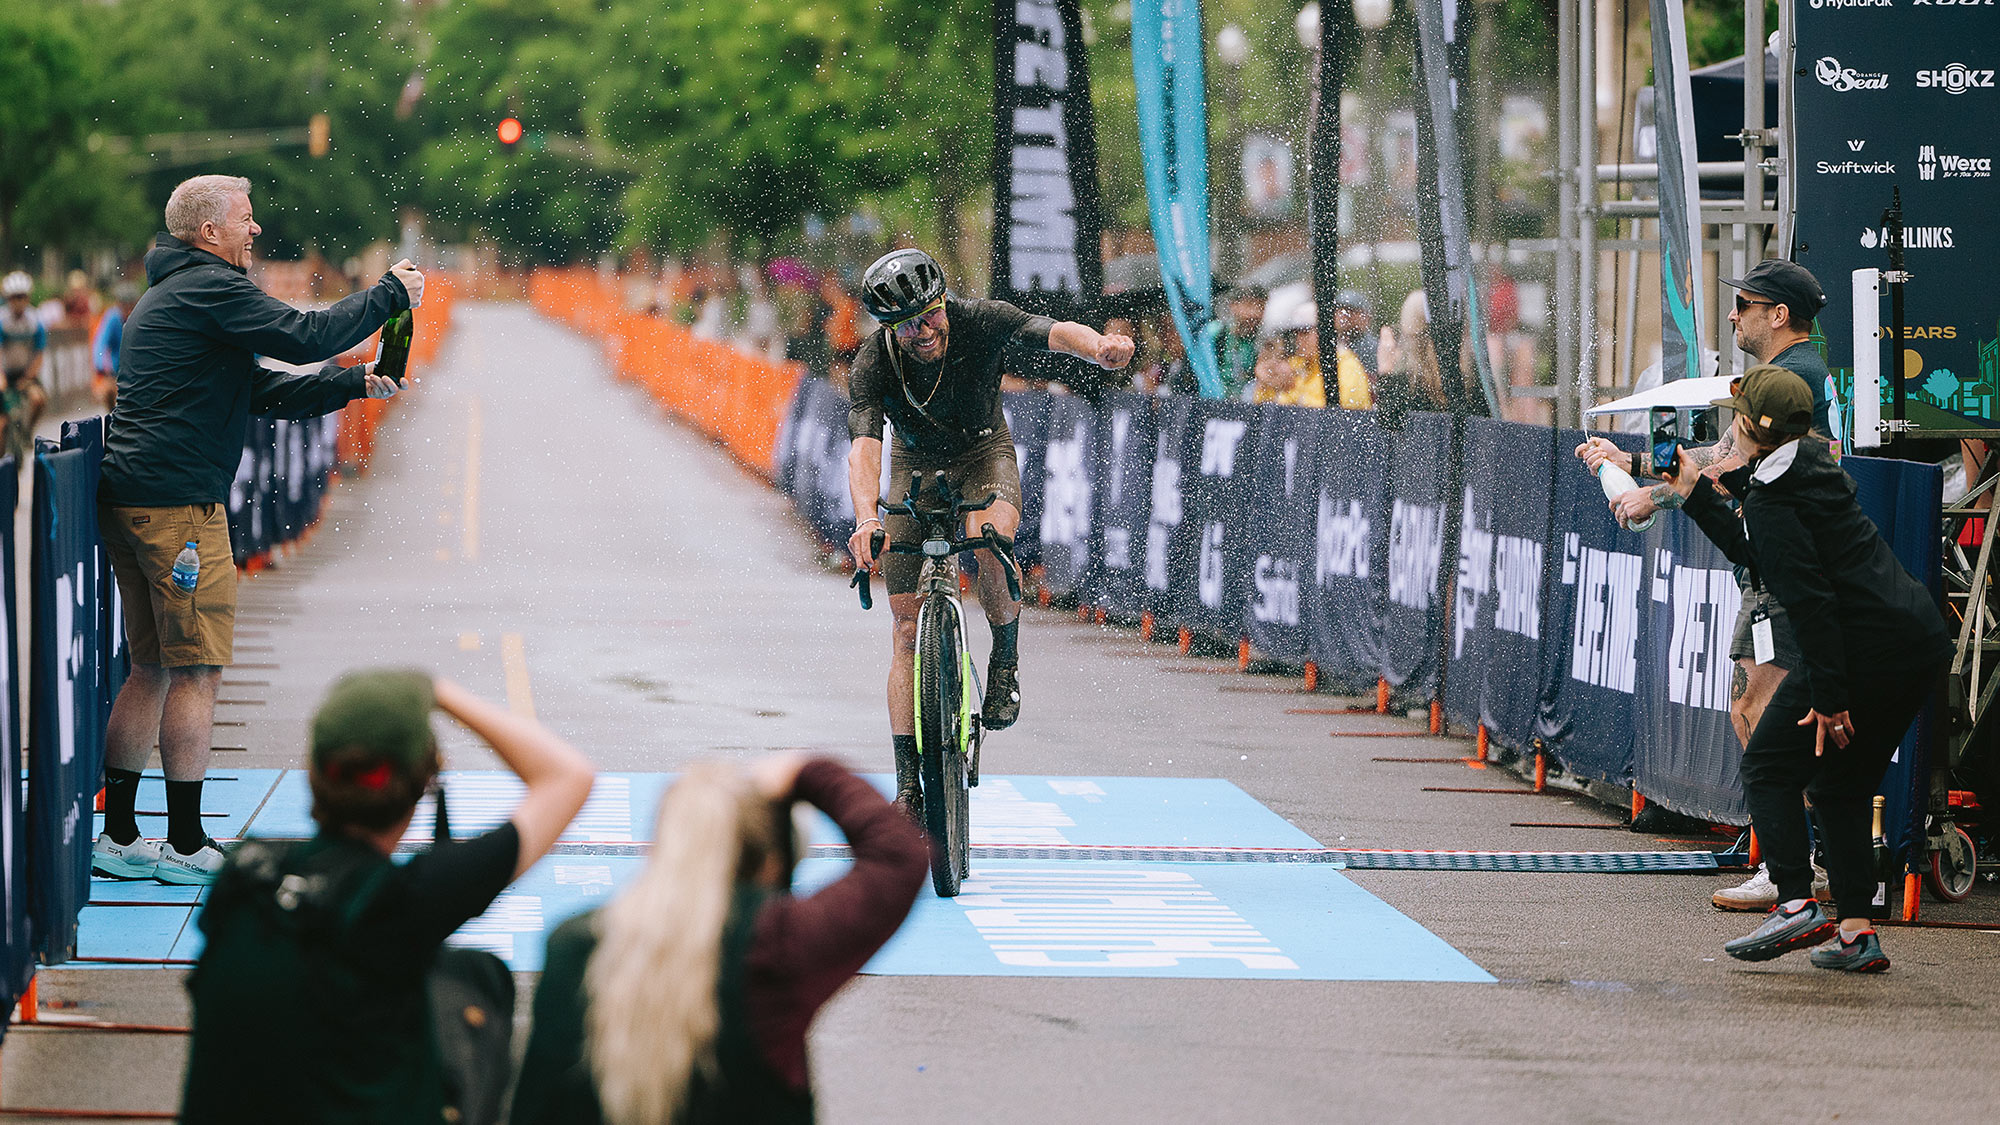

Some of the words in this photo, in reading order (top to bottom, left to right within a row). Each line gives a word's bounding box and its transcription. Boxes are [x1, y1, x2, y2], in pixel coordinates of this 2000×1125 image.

[1832, 68, 1889, 92] Seal
[1916, 70, 1995, 88] SHOKZ
[1816, 161, 1896, 174] Swiftwick
[1938, 155, 1992, 171] Wera
[1880, 227, 1953, 248] AHLINKS
[1885, 326, 1957, 339] YEARS
[165, 854, 184, 866] Mount
[184, 861, 191, 869] to
[190, 863, 209, 875] Coast
[954, 869, 1300, 970] SHIMANO
